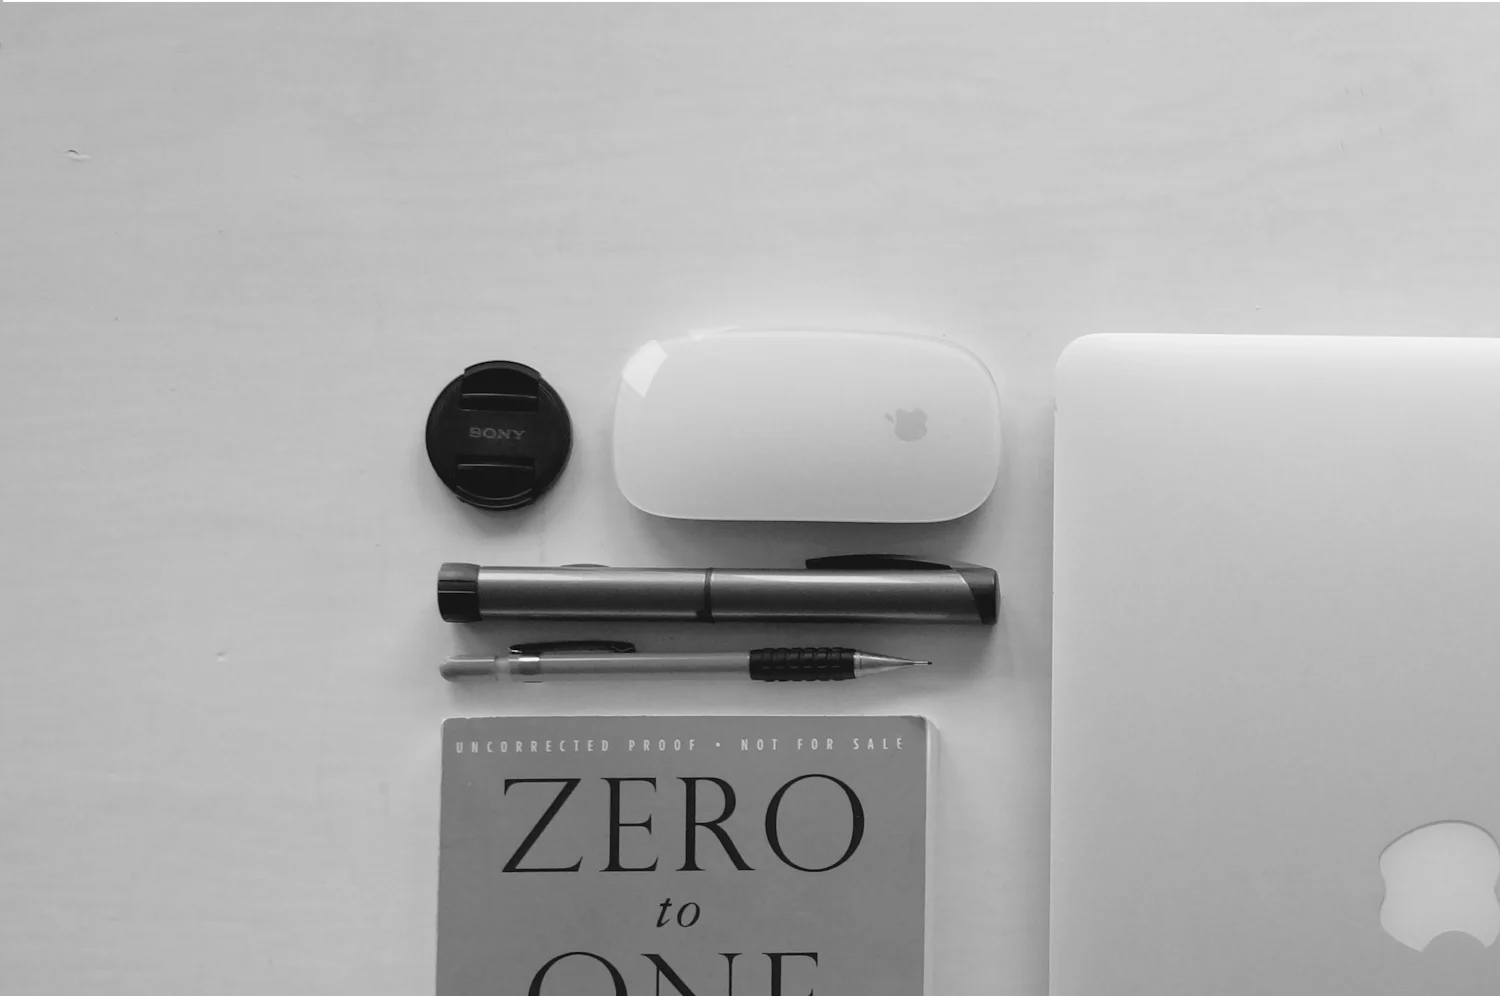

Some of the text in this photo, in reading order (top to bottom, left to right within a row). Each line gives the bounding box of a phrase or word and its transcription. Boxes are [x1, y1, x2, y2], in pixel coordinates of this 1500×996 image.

[469, 426, 526, 440] SONY
[455, 737, 904, 754] UNCORRECTED PROOF NOT FOR SALE
[501, 773, 865, 873] ZERO
[655, 897, 701, 928] to
